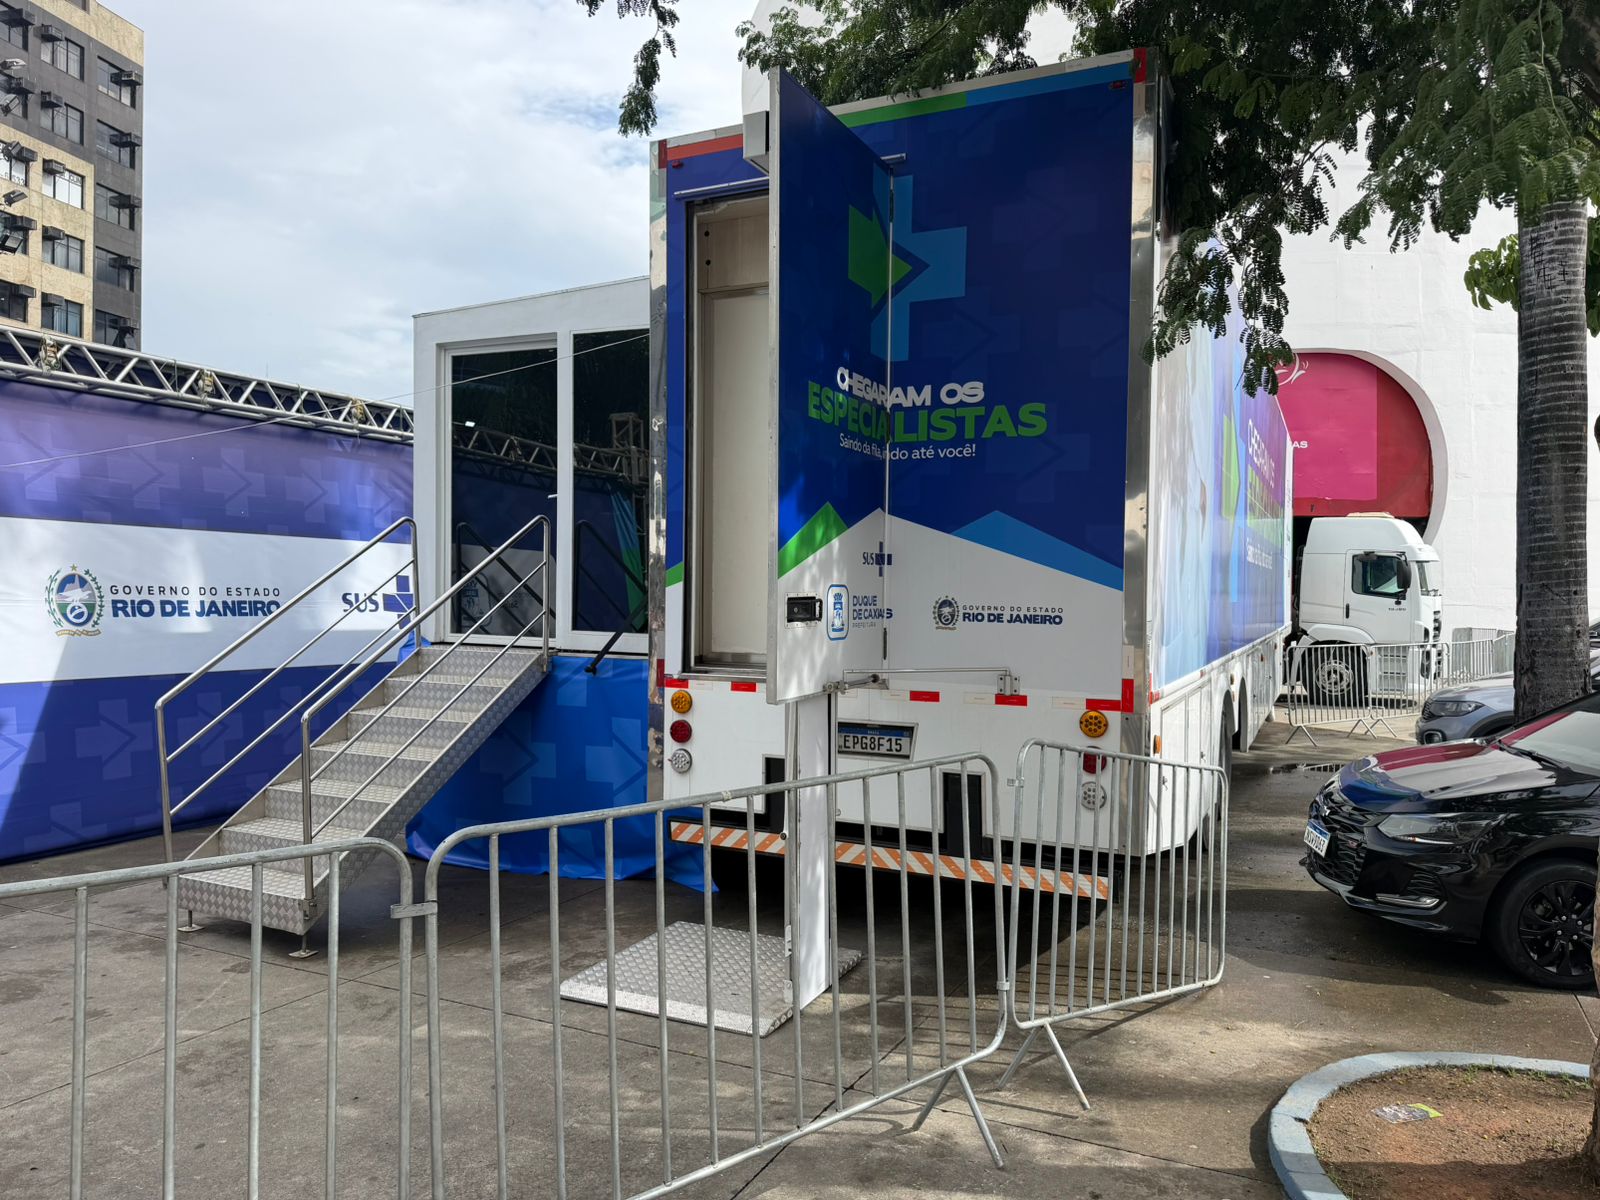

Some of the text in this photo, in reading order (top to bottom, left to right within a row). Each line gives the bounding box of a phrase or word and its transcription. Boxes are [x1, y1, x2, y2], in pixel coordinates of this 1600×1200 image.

[836, 366, 985, 408] CHEGARAM OS
[808, 380, 1047, 443] ESPECIALISTAS
[839, 432, 862, 452] Saindo
[862, 441, 871, 455] da
[911, 447, 934, 459] até
[938, 443, 976, 458] você!
[862, 551, 875, 566] SUS
[110, 585, 280, 597] GOVERNO DO ESTADO
[111, 599, 281, 618] RIO DE JANEIRO
[341, 592, 380, 613] SUS
[852, 595, 878, 607] DUQUE
[962, 604, 1064, 614] GOVERNO DO ESTADO
[852, 608, 893, 621] DE CAXIAS
[962, 612, 1064, 625] RIO DE JANEIRO
[843, 734, 903, 753] EPG8F15
